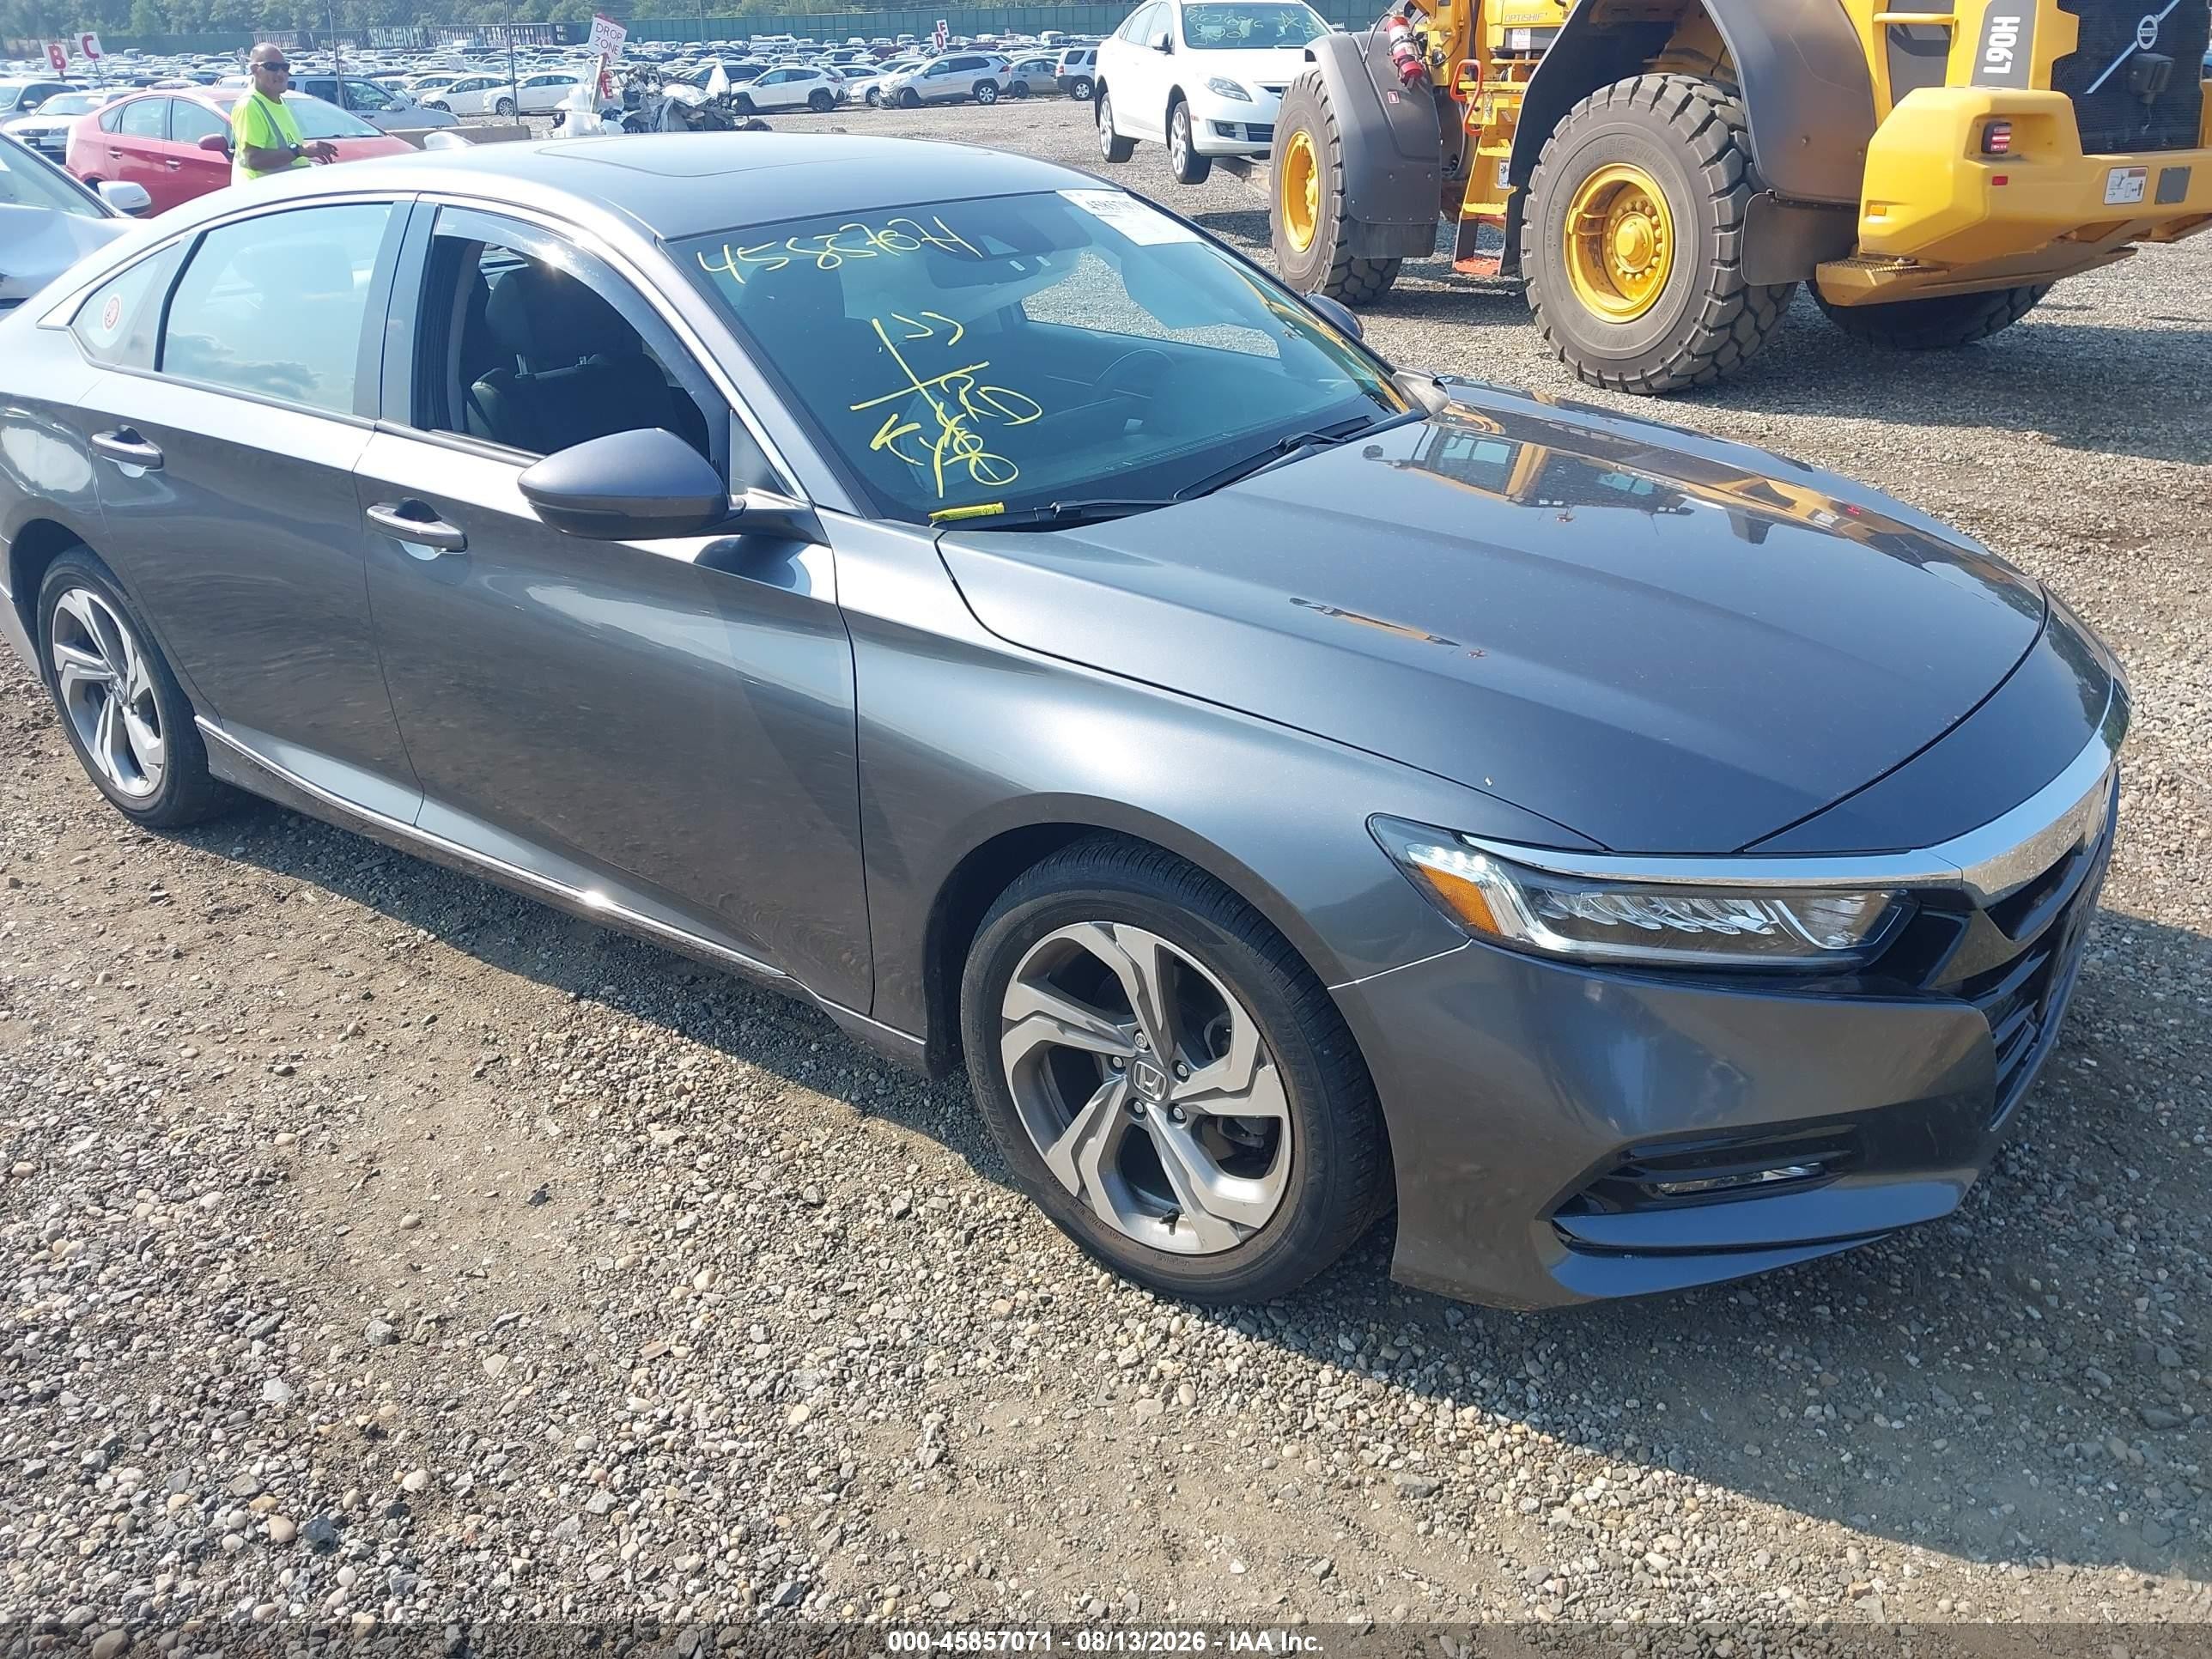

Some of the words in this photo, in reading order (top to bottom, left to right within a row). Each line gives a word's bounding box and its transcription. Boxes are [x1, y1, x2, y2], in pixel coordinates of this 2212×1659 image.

[1504, 11, 1547, 22] OPTISHIF
[595, 22, 623, 40] DROP
[82, 34, 100, 59] C
[594, 35, 620, 55] ZONE
[1983, 16, 2021, 74] L90H
[47, 45, 66, 70] B
